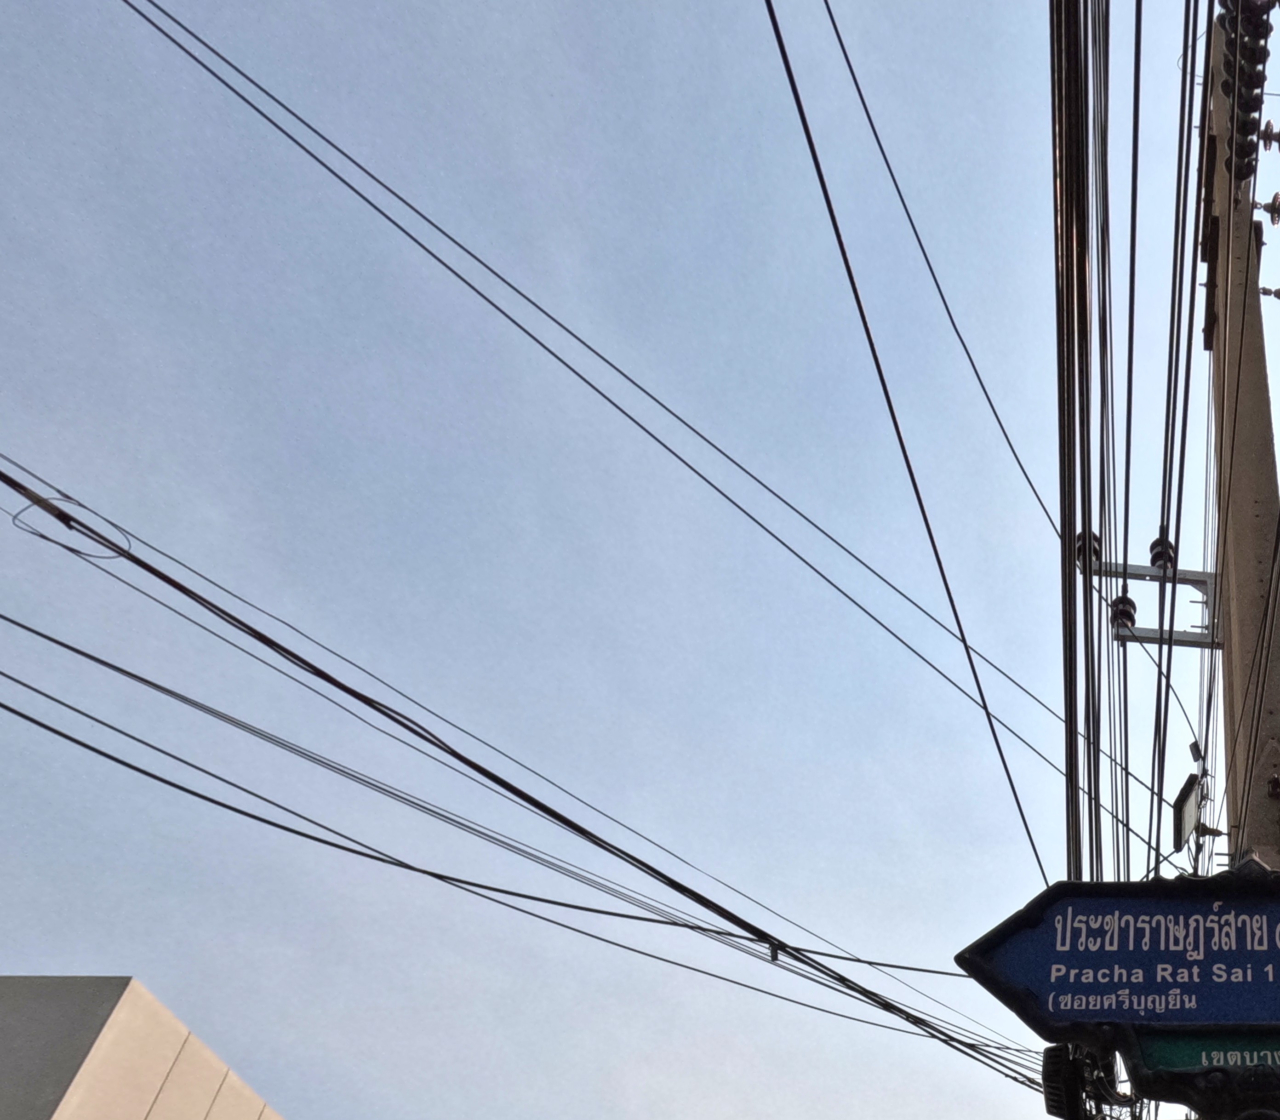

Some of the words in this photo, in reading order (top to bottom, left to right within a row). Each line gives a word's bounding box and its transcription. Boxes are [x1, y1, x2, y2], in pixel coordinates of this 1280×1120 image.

[1054, 902, 1269, 961] ประชาราษฎร์สาย
[1050, 964, 1144, 983] Pracha
[1156, 963, 1201, 983] Rat
[1212, 963, 1252, 983] Sai
[1264, 964, 1275, 982] 1
